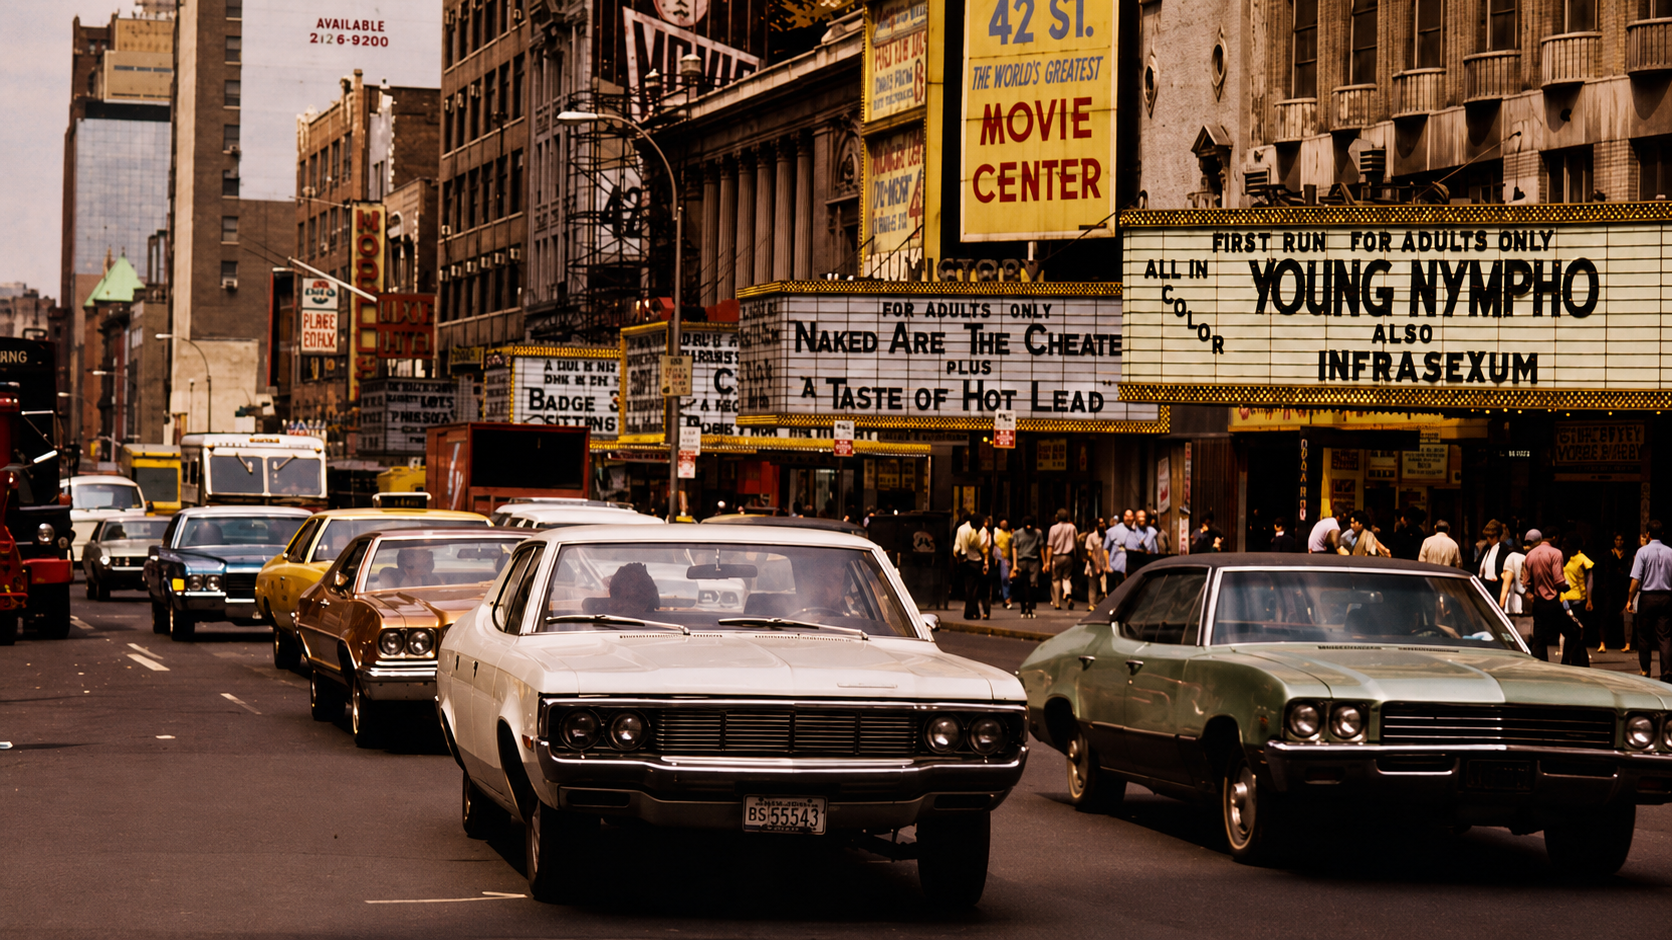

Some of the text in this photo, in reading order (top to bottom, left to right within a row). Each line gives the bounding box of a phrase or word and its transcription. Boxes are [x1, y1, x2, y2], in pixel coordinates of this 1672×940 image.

[316, 17, 385, 32] AVAILABLE
[988, 0, 1034, 45] 42
[972, 56, 1104, 90] THE WORLD'S GREATEST
[980, 96, 1092, 146] MOVIE
[973, 157, 1102, 204] CENTER
[1213, 230, 1554, 252] FIRST RUN FOR ADULTS ONLY
[1145, 259, 1208, 279] ALL IN
[1249, 257, 1599, 318] YOUNG NYMPHO
[883, 302, 1051, 318] FOR ADULTS ONLY
[1162, 285, 1224, 354] COLOR
[795, 321, 878, 353] NAKED
[889, 322, 946, 354] ARE
[964, 323, 1010, 355] THE
[1372, 324, 1433, 344] ALSO
[946, 360, 992, 375] PLUS
[1318, 350, 1539, 384] INFRASEXUM
[529, 387, 596, 412] BADGE
[826, 377, 902, 410] TASTE
[914, 387, 949, 410] OF
[963, 379, 1017, 411] HOT
